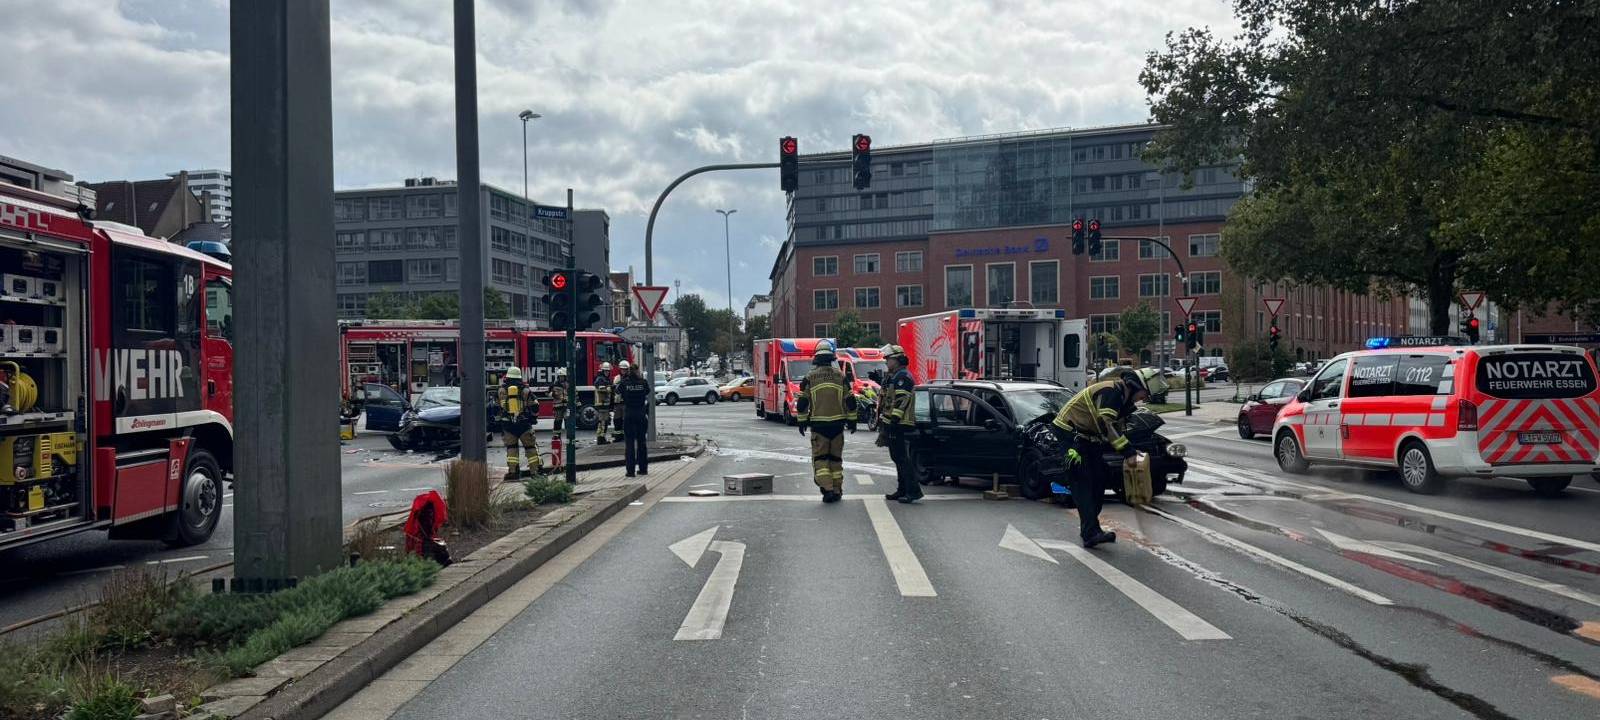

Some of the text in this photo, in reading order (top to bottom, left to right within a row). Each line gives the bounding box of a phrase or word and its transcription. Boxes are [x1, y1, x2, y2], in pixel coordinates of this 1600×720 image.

[537, 207, 567, 218] Kruppstr.
[1005, 244, 1029, 255] Bank
[183, 274, 194, 295] 1B
[1400, 337, 1443, 346] NOTARZT
[94, 348, 184, 401] WEHR
[522, 367, 560, 383] WEH
[1354, 365, 1394, 379] NOTARZT
[1485, 360, 1584, 379] NOTARZT
[1353, 378, 1376, 386] FEUERWEHR
[1489, 380, 1588, 390] FEUERWEHR ESSEN
